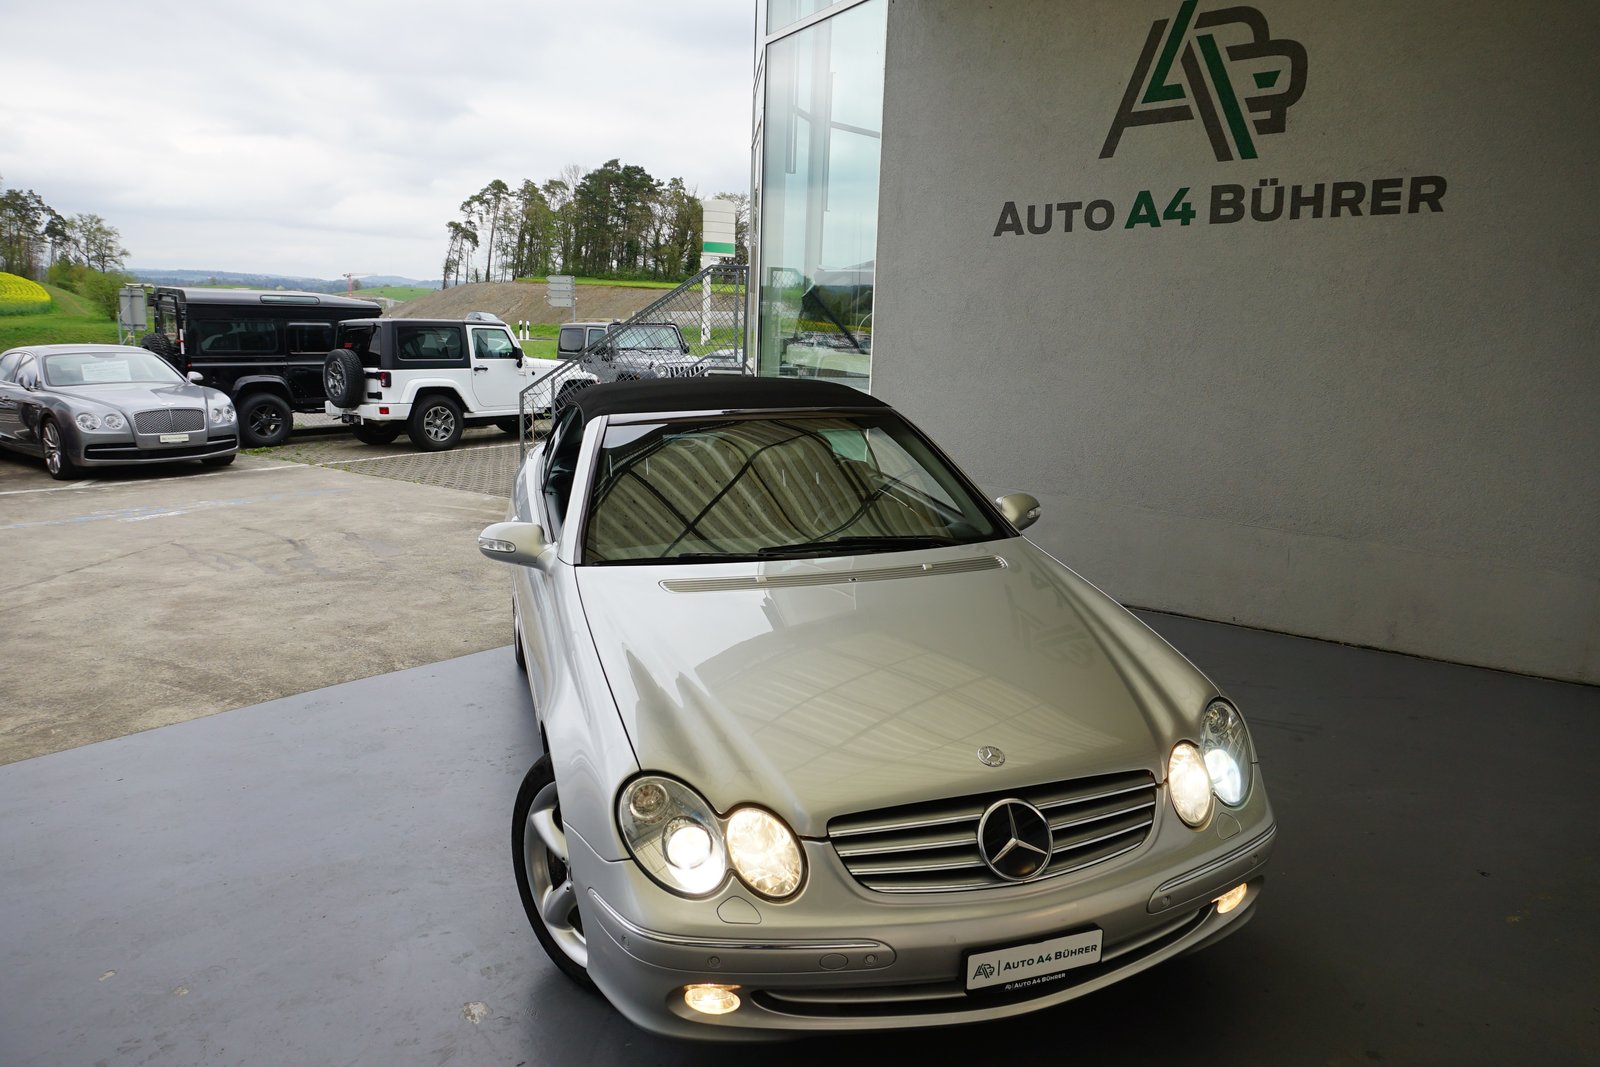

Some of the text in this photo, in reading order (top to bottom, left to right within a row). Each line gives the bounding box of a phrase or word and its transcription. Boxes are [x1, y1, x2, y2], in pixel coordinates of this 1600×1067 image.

[993, 175, 1448, 237] AUTO A4 BÜHRER
[1003, 958, 1035, 971] AUTO
[1037, 953, 1053, 964] A4
[1054, 944, 1098, 960] BÜHRER
